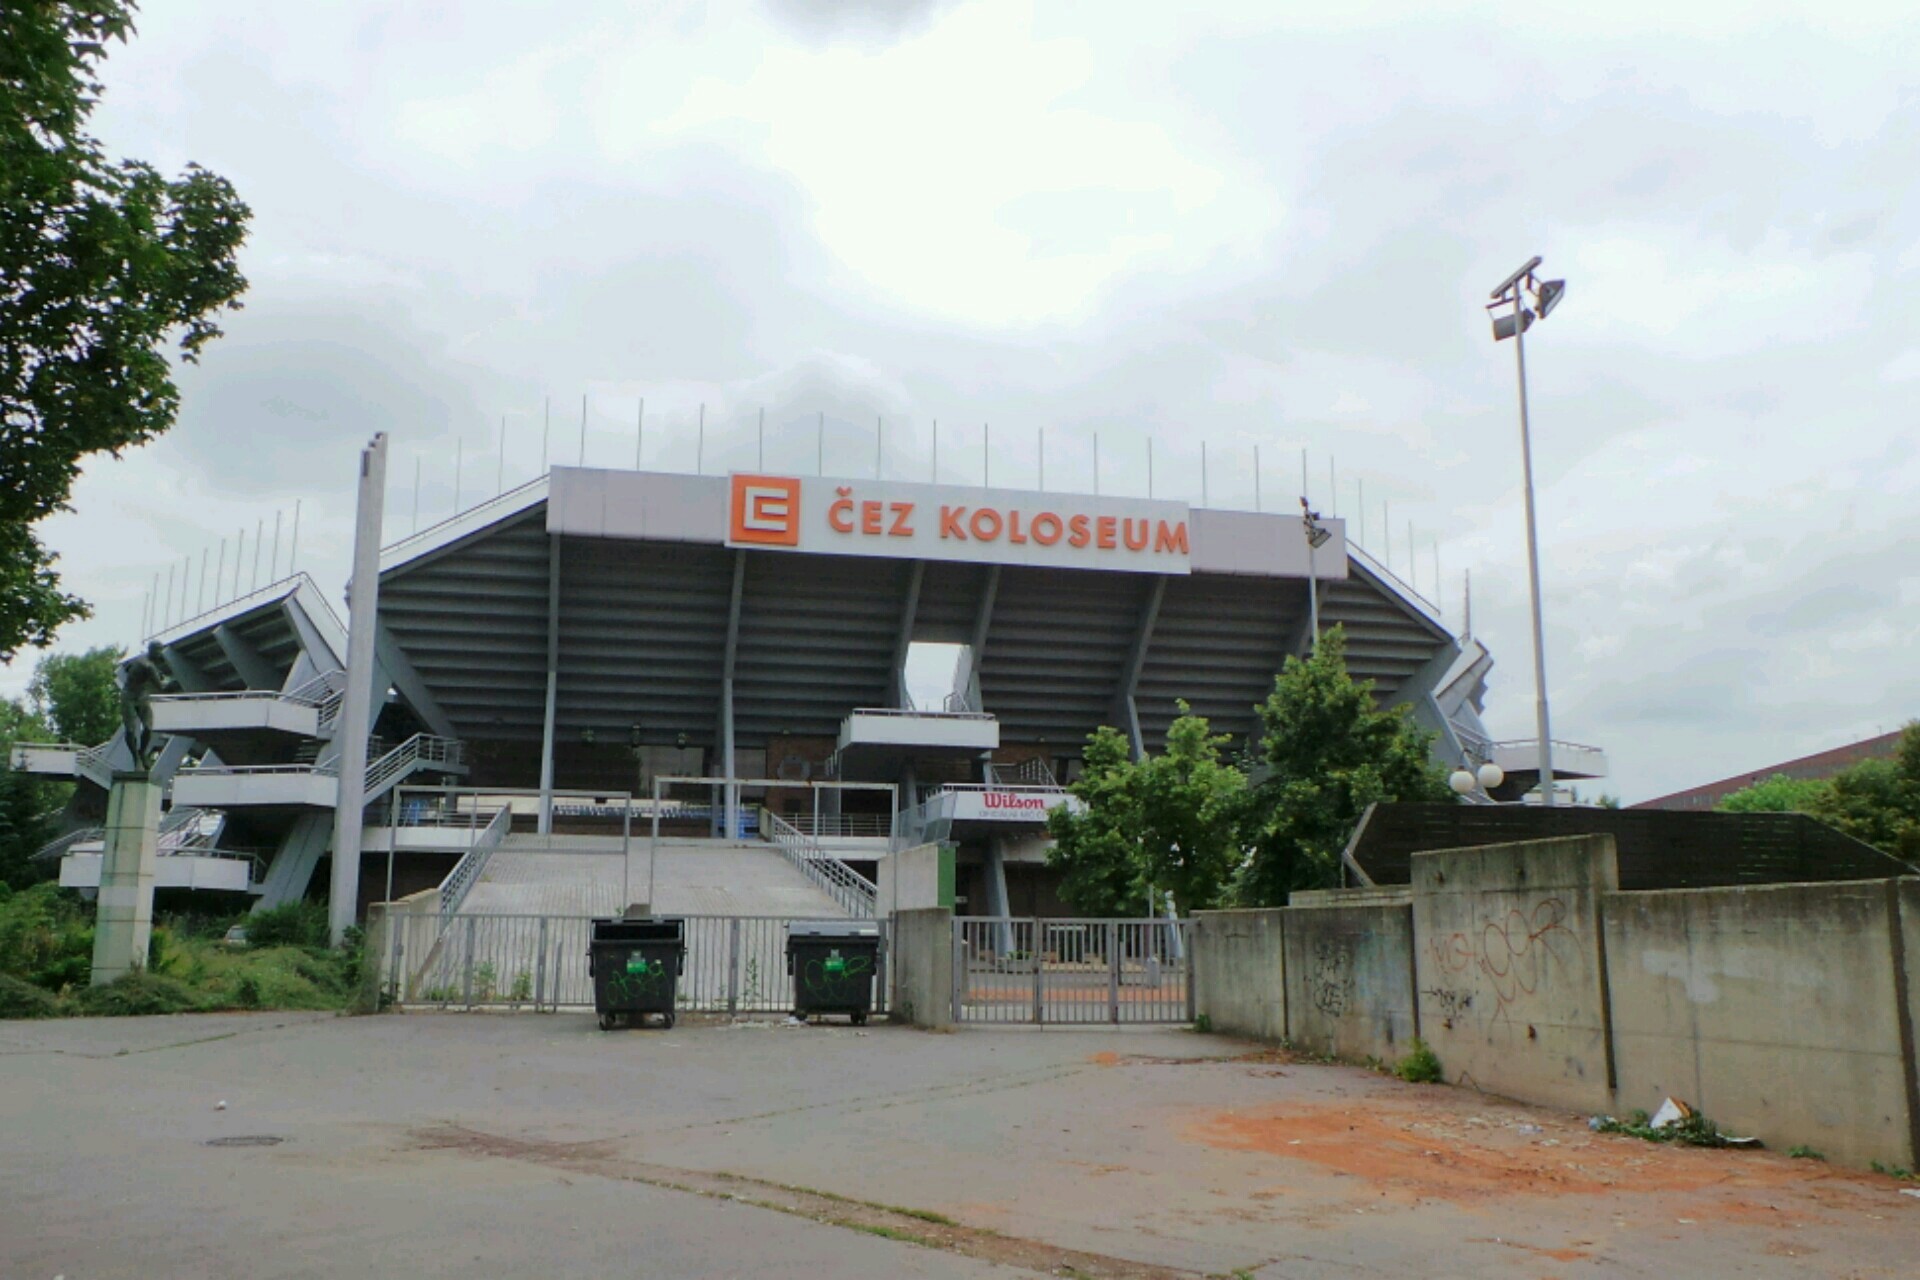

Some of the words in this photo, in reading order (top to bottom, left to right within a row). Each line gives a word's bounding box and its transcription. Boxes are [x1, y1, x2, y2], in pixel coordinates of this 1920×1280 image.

[828, 486, 915, 536] ČEZ
[940, 505, 1190, 554] KOLOSEUM
[984, 793, 1044, 809] Wilson
